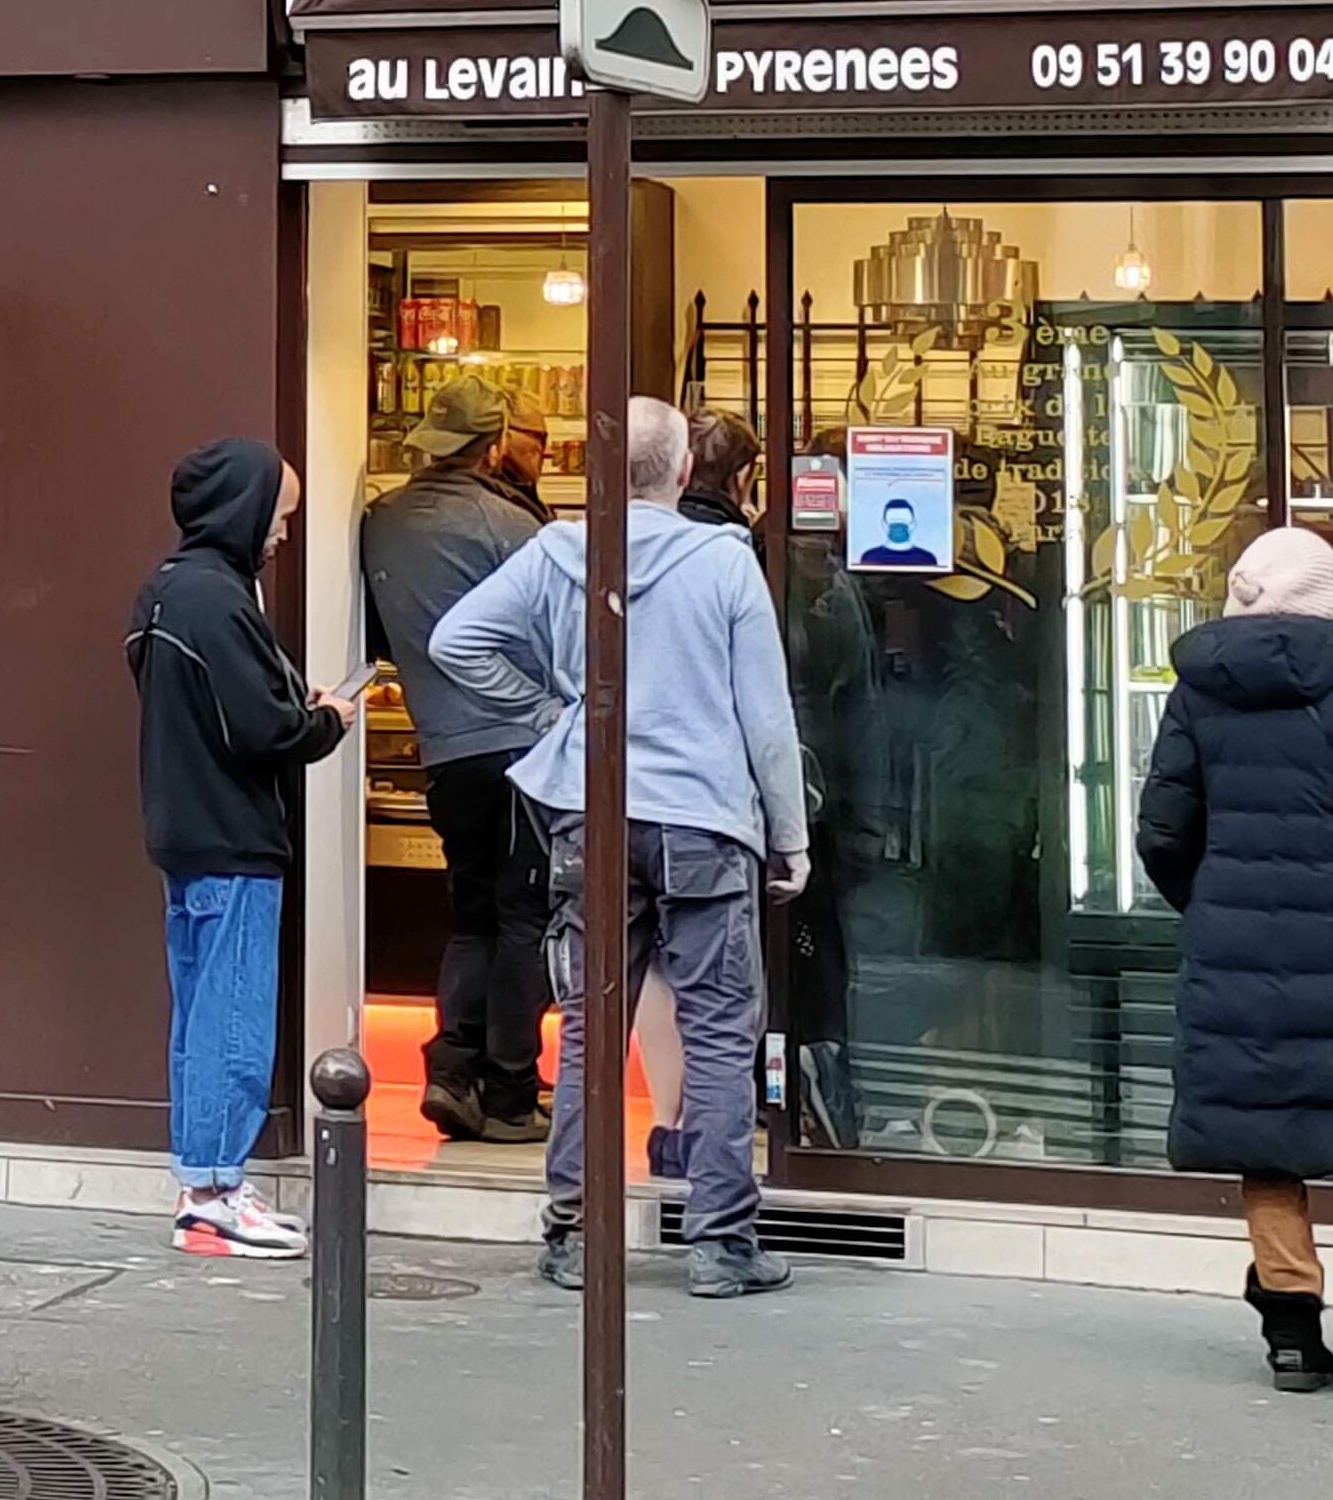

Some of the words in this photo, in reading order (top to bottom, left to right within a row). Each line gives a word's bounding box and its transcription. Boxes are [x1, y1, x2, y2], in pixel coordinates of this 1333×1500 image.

[1032, 44, 1083, 88] 09
[1096, 42, 1143, 88] 51
[1159, 40, 1211, 85] 39
[1223, 39, 1276, 83] 90
[1288, 38, 1333, 83] 04
[1023, 358, 1121, 387] grn
[975, 424, 1113, 451] Bagute
[954, 459, 989, 481] de
[999, 458, 1144, 481] tradio
